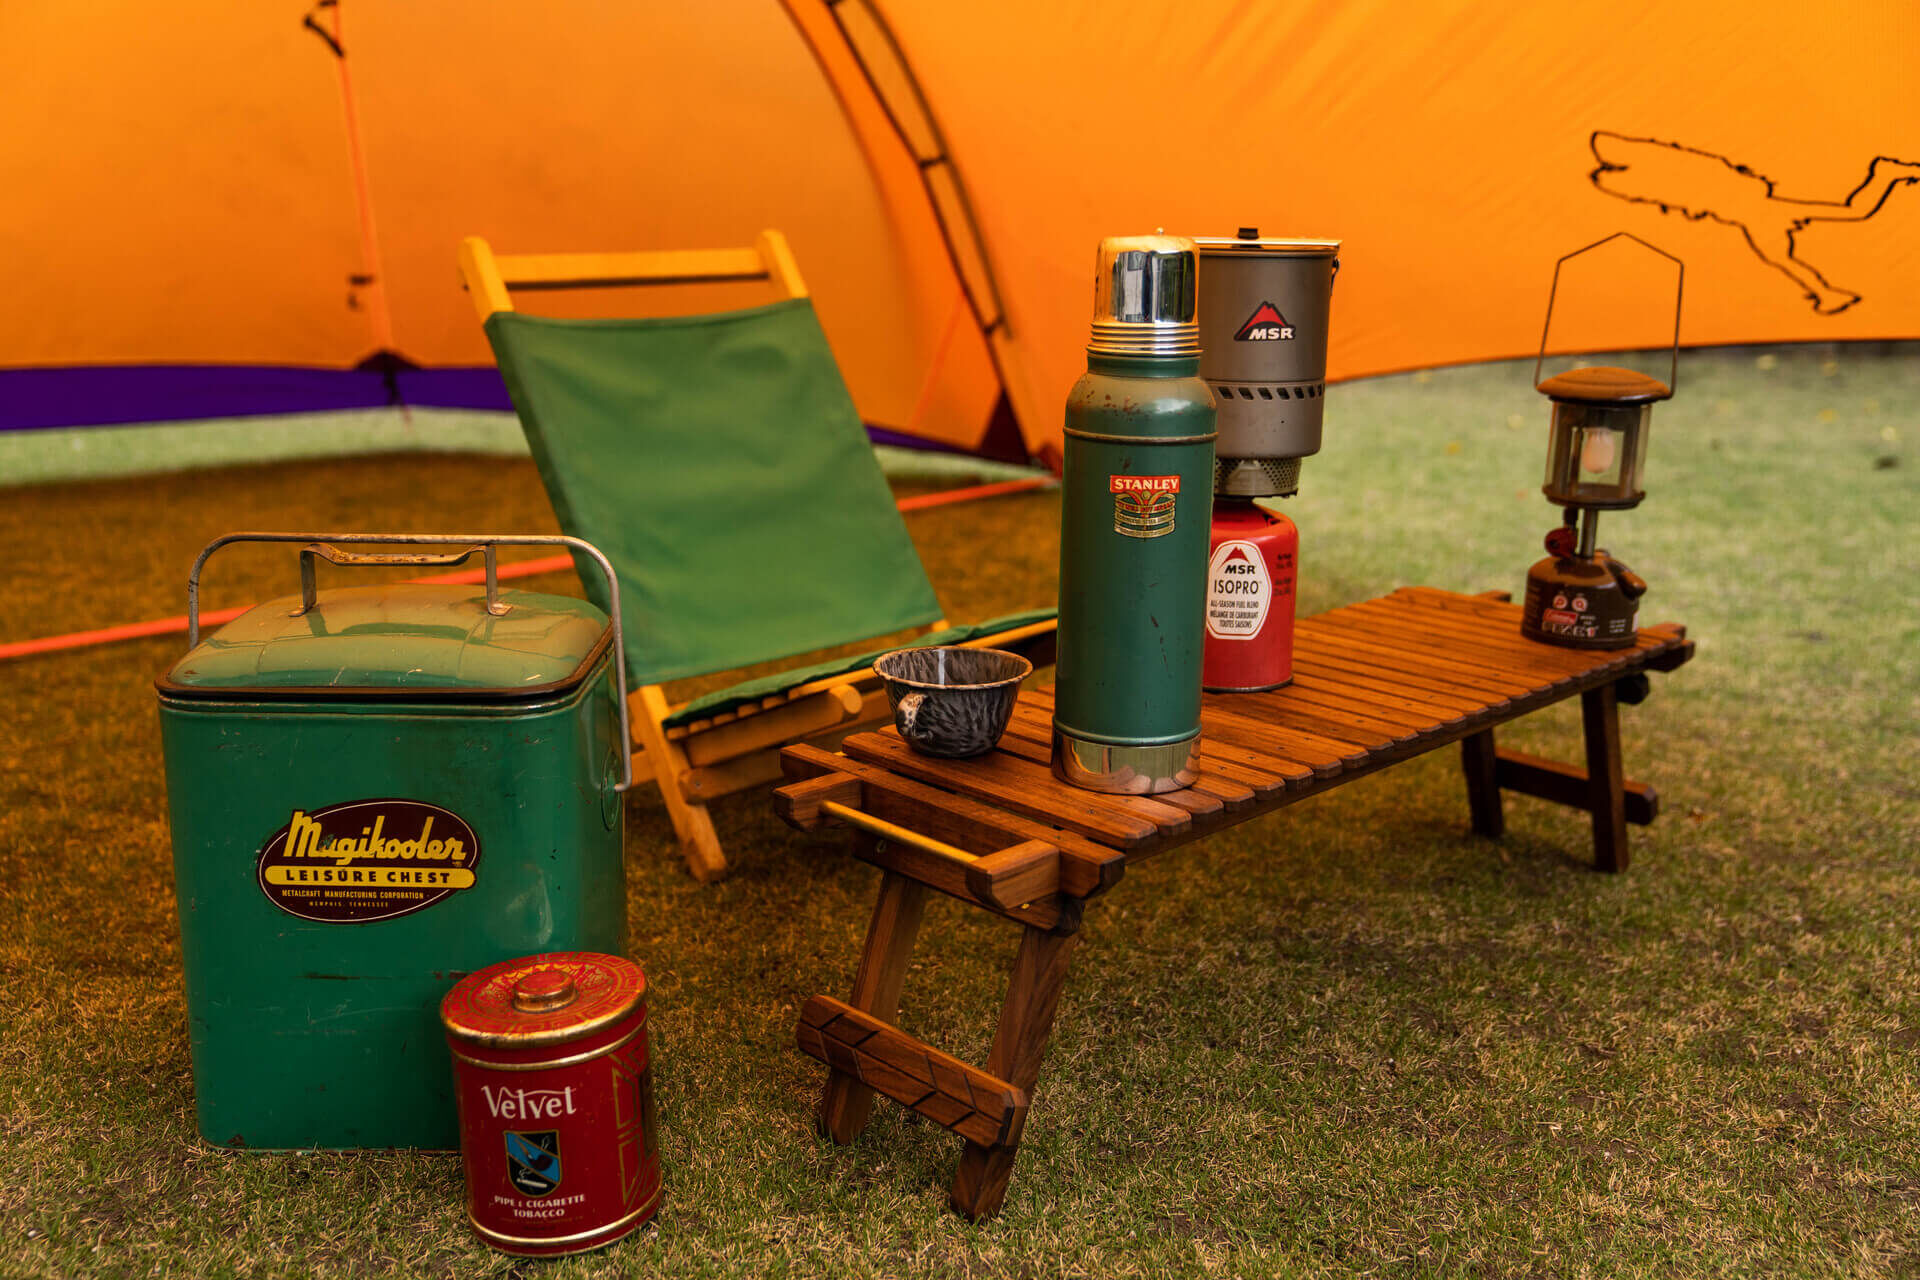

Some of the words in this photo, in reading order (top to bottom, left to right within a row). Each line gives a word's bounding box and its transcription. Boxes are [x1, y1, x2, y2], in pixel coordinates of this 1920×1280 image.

[1248, 327, 1294, 340] MSR
[1114, 478, 1179, 490] STANLEY
[1224, 564, 1256, 575] MSR
[1213, 580, 1259, 595] ISOPRO
[1210, 600, 1236, 608] ALL-SEASON
[1235, 620, 1252, 628] SAISONS
[286, 869, 377, 883] LEISURE
[387, 871, 451, 884] CHEST
[281, 889, 321, 898] METALCRAFT
[324, 890, 377, 899] MANUFACTURING
[380, 891, 424, 900] CORPORATION
[481, 1085, 577, 1120] Velvet
[494, 1195, 515, 1207] PIPE
[526, 1194, 585, 1208] CIGARETTE
[513, 1208, 565, 1218] TOBACCO
